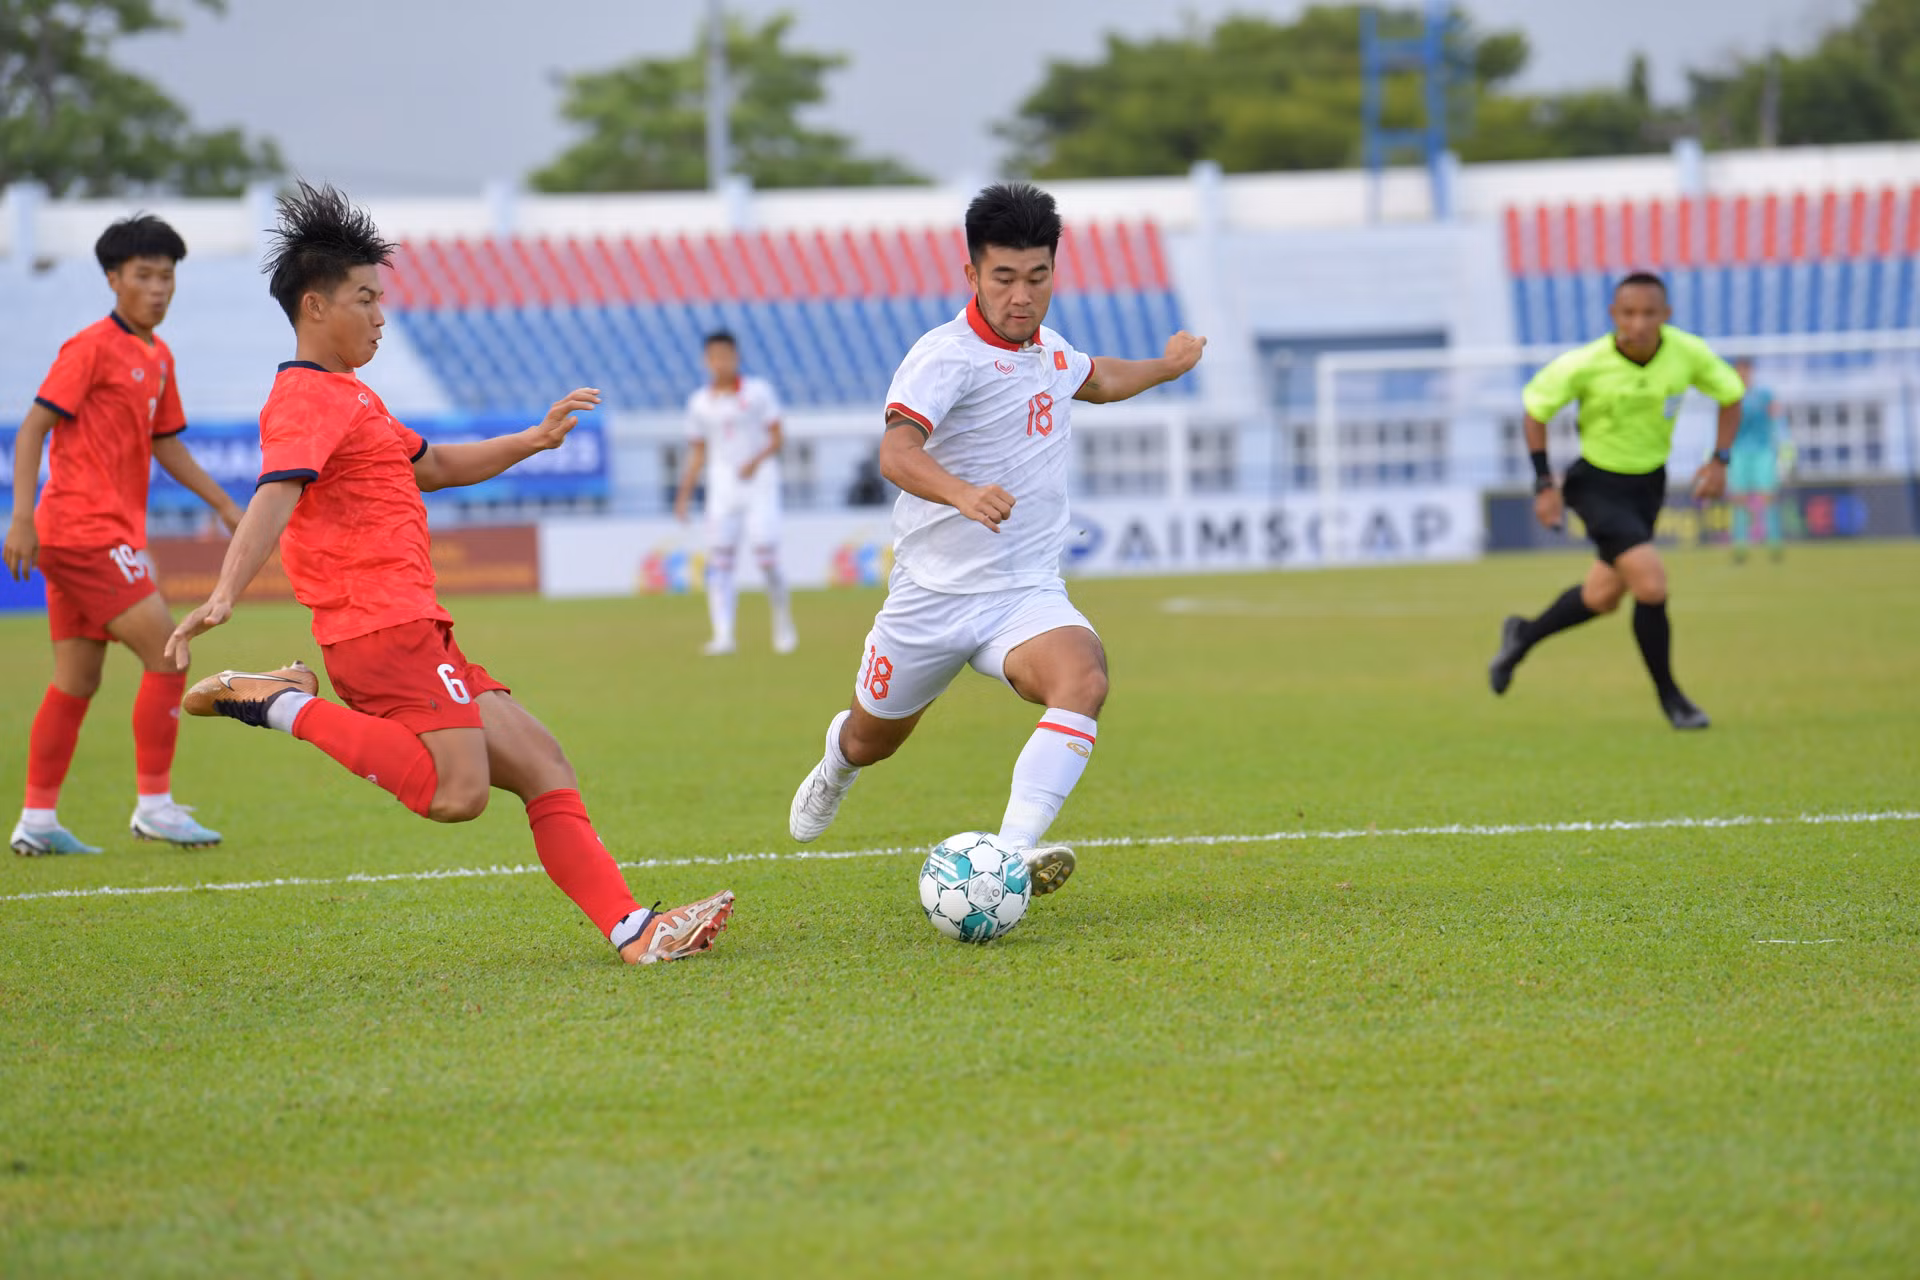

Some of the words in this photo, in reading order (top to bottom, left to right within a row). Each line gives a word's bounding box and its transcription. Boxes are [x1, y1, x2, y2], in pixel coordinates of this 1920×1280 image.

[1026, 391, 1054, 437] 18
[1116, 504, 1453, 563] AIMSCAP
[109, 543, 146, 584] 19
[436, 663, 471, 705] 6
[862, 644, 894, 701] 18
